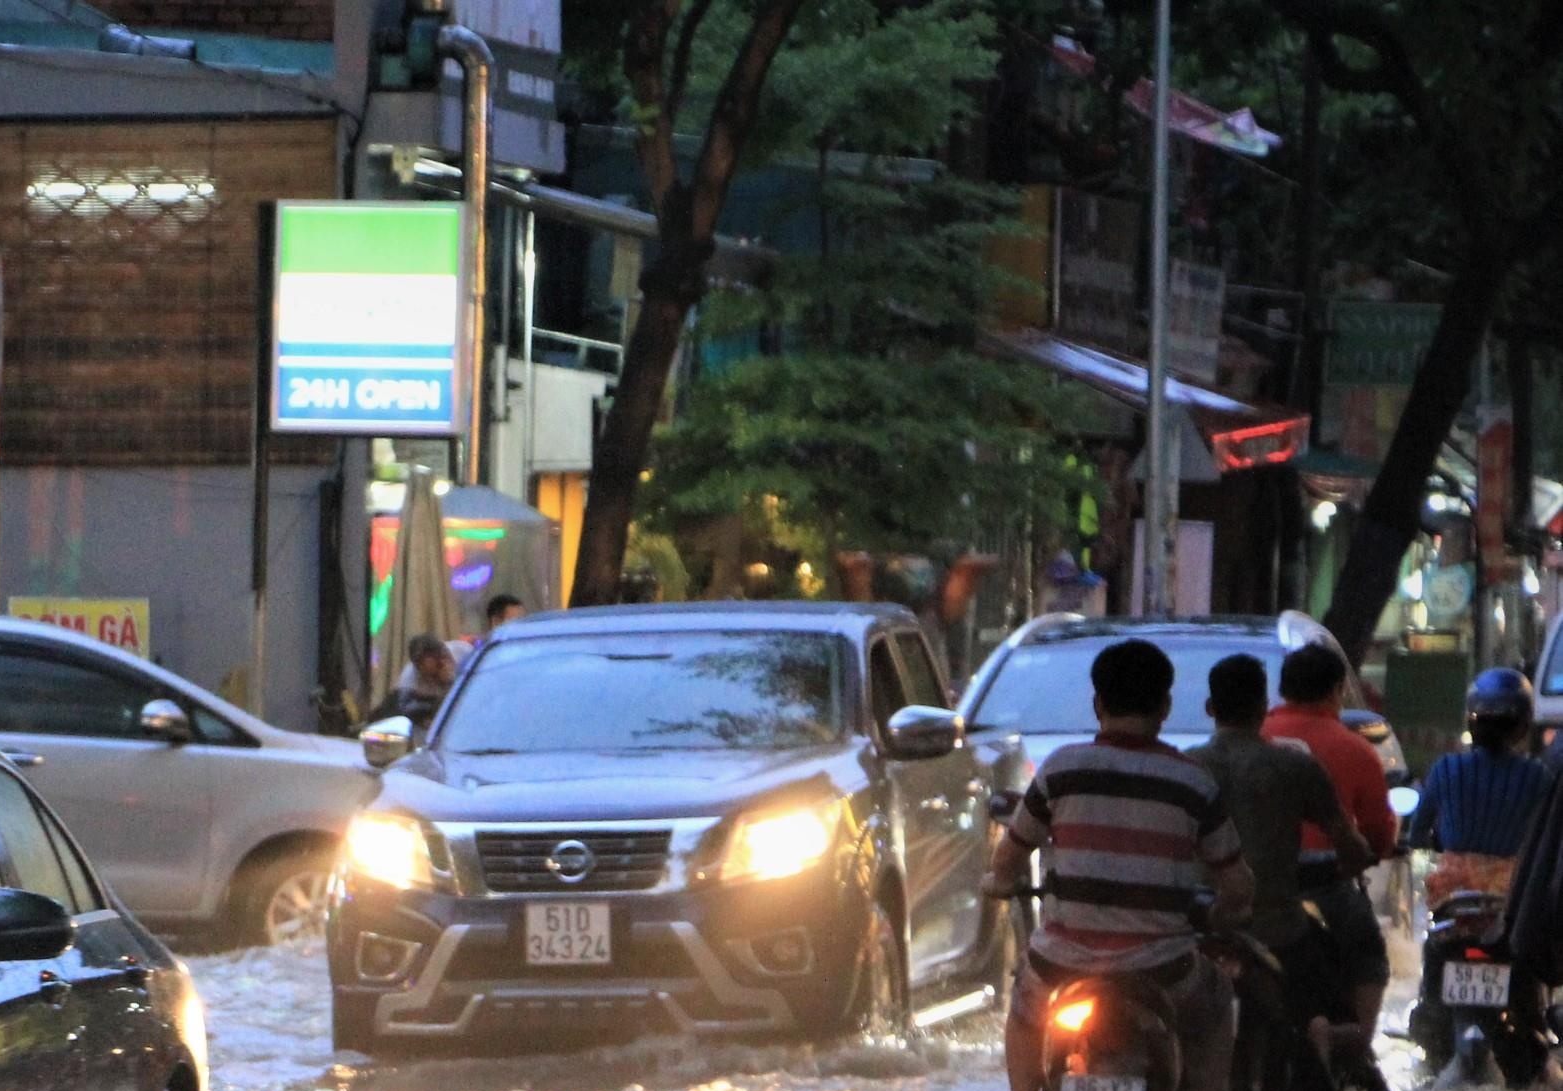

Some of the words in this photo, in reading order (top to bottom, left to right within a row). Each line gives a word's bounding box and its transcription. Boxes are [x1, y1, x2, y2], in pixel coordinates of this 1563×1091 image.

[288, 377, 350, 408] 24H
[355, 379, 441, 410] OPEN
[99, 606, 141, 649] GÀ
[546, 906, 590, 932] 51D
